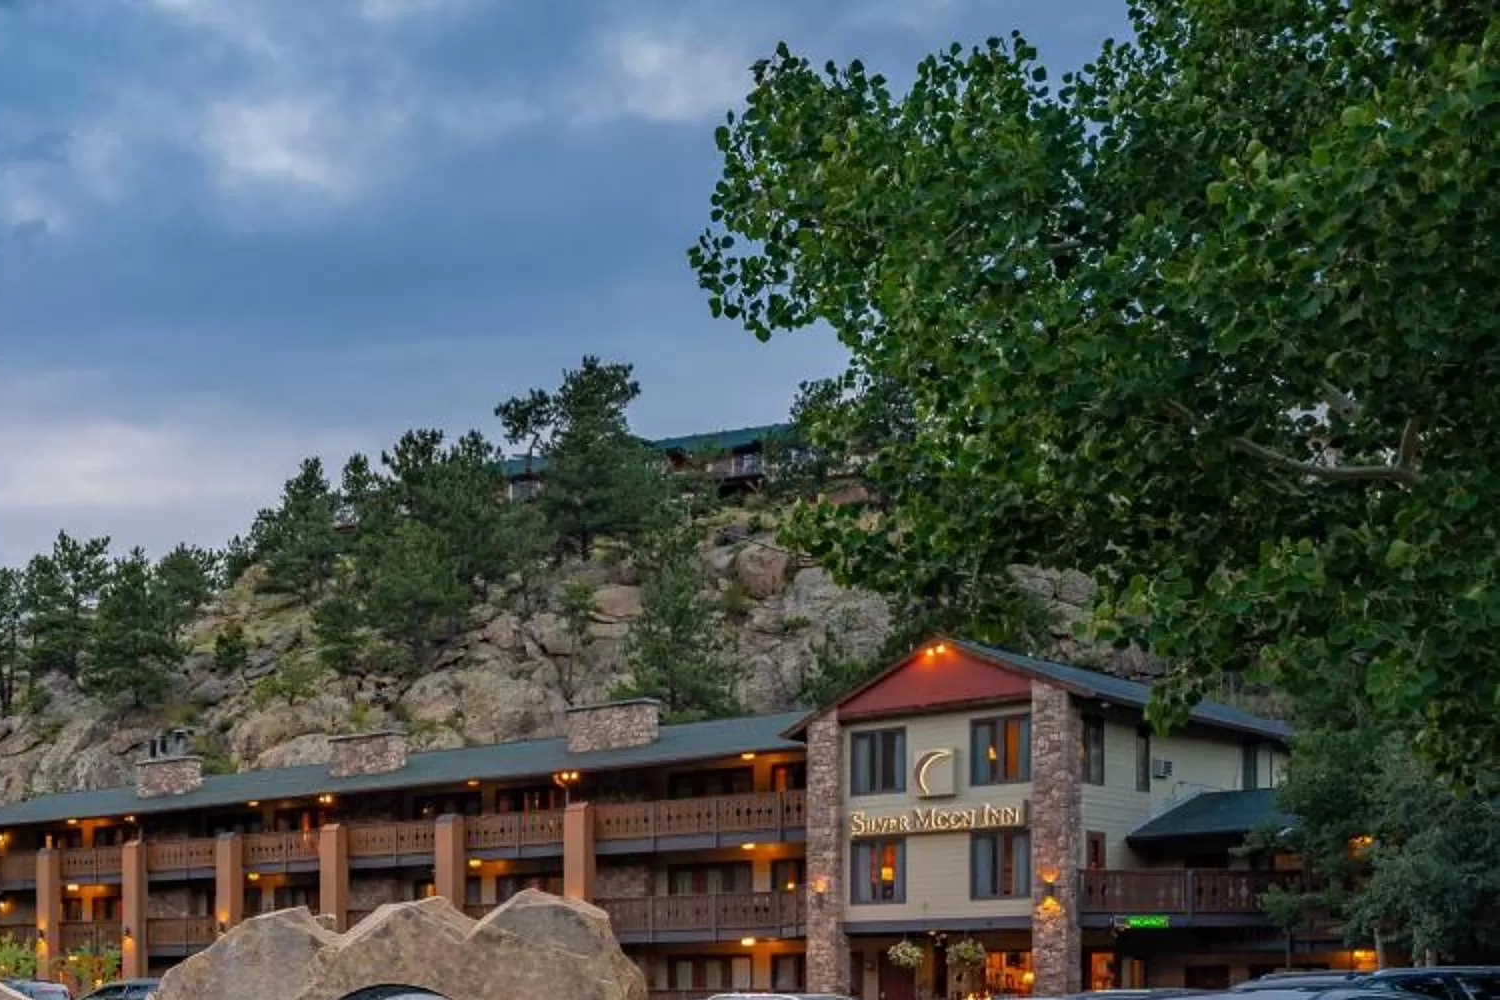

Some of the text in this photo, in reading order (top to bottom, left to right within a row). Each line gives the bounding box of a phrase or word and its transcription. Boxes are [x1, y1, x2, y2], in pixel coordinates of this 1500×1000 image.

[851, 803, 1020, 834] SILVER MOON INN
